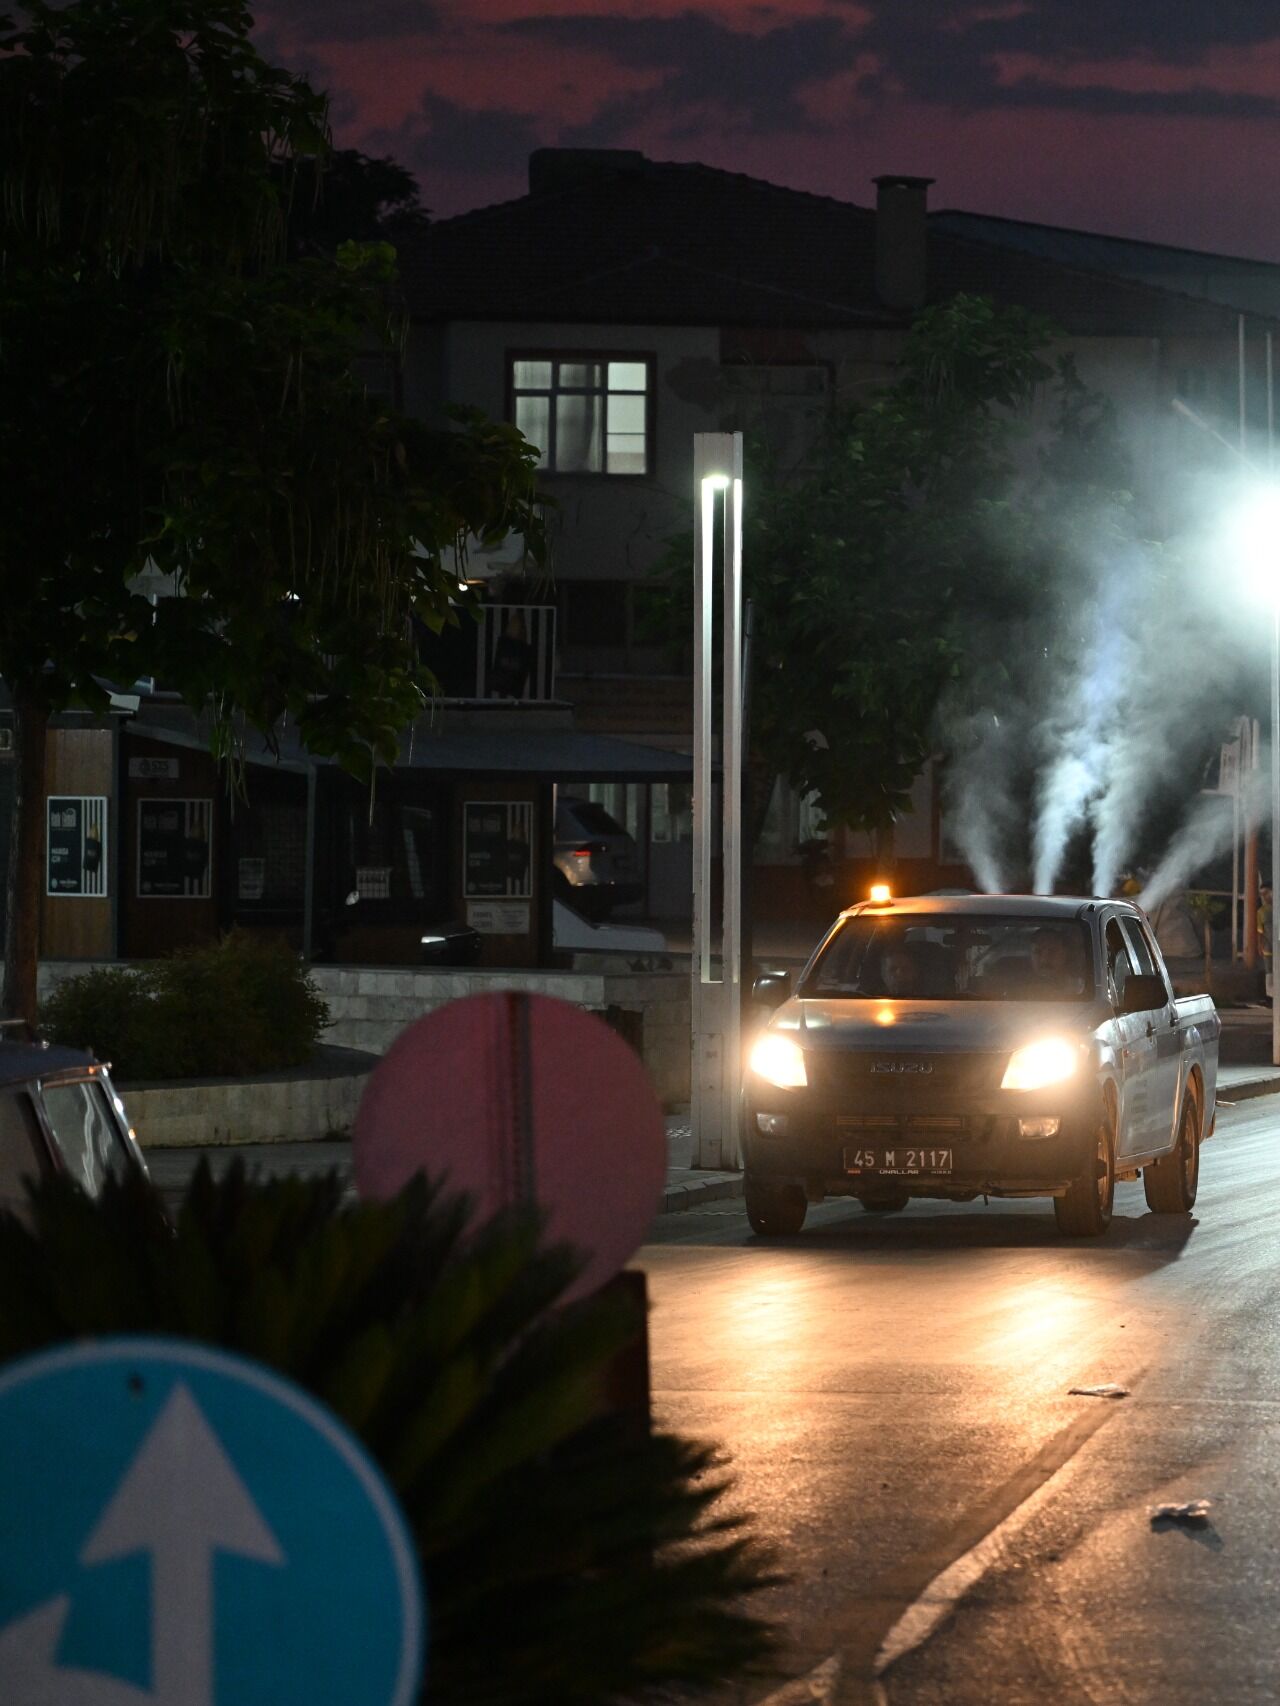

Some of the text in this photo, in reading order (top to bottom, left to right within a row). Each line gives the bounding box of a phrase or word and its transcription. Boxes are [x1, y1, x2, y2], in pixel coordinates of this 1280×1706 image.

[870, 1063, 934, 1074] ISUZU
[854, 1151, 949, 1167] 45 M 2117
